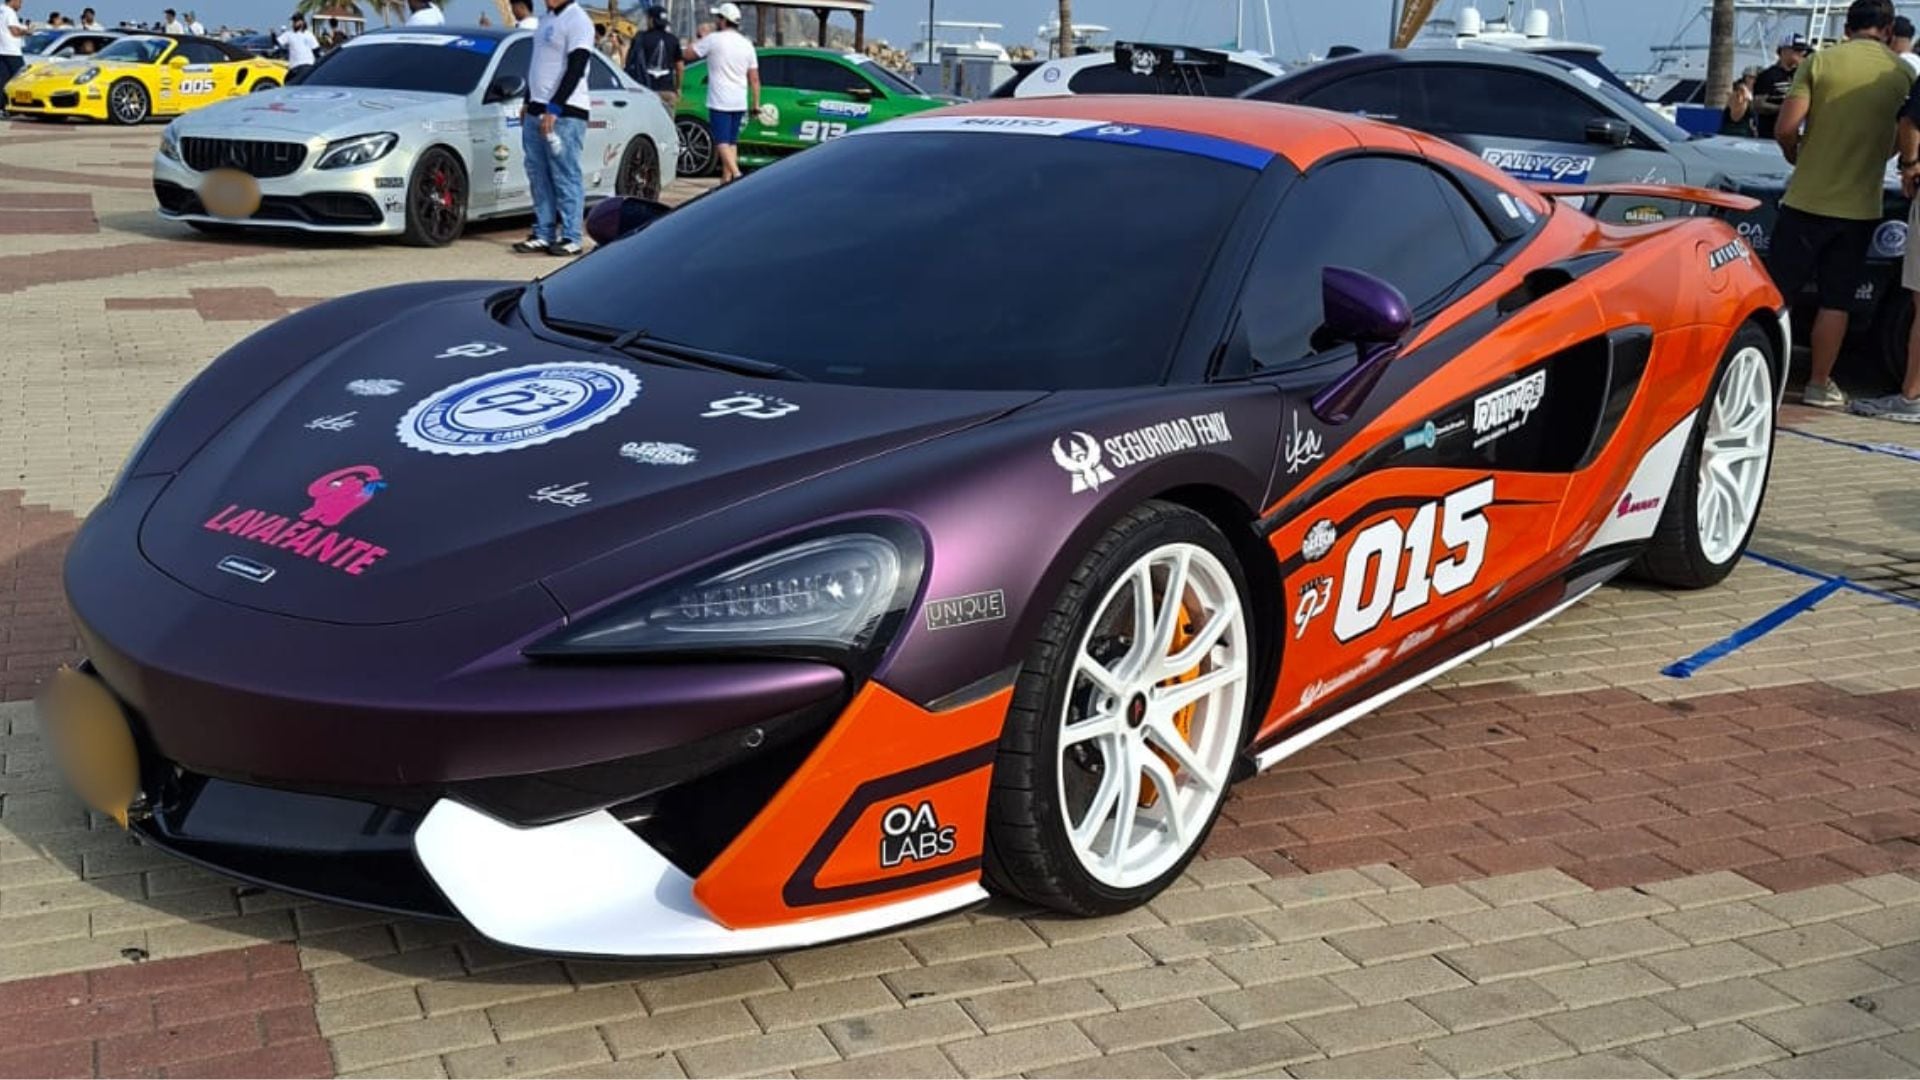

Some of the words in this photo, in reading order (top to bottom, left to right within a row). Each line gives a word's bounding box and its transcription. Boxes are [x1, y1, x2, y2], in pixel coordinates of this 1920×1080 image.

[181, 79, 213, 94] 005
[1486, 151, 1550, 172] RALLY
[700, 396, 800, 419] 93
[1104, 417, 1198, 469] SEGURIDAD
[1190, 411, 1233, 446] FENIX
[1285, 408, 1325, 474] ika
[204, 504, 390, 576] LAVAFANTE
[1333, 478, 1495, 642] 015
[929, 593, 1000, 621] UNIQUE
[884, 803, 937, 836] OA
[883, 828, 955, 867] LABS
